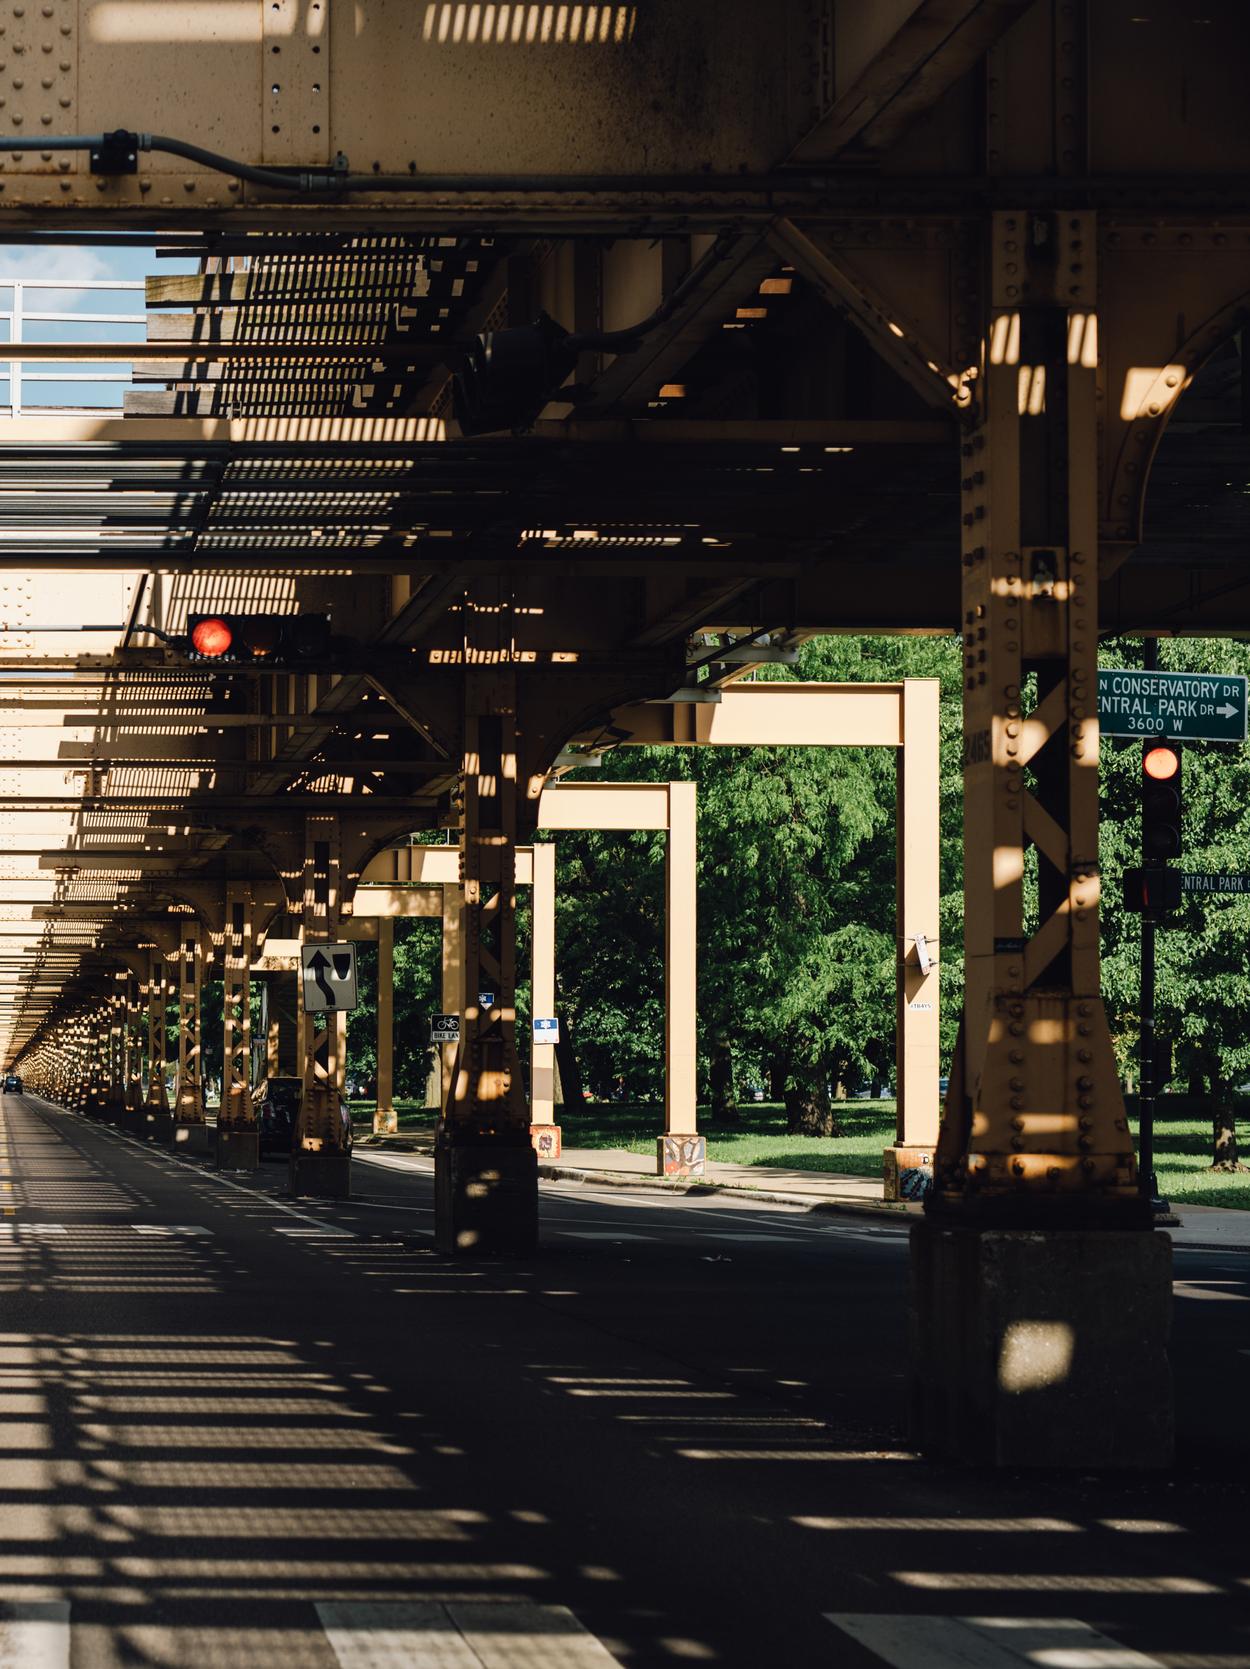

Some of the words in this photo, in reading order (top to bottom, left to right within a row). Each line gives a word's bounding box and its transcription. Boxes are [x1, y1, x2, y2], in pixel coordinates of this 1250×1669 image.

[1099, 679, 1108, 691] N
[1112, 676, 1219, 699] CONSERVATORY
[1223, 685, 1240, 698] DR
[1158, 699, 1198, 718] PARK
[1200, 704, 1215, 716] DR
[1128, 717, 1164, 731] 3600
[1173, 719, 1183, 732] W
[1219, 876, 1244, 891] PARK
